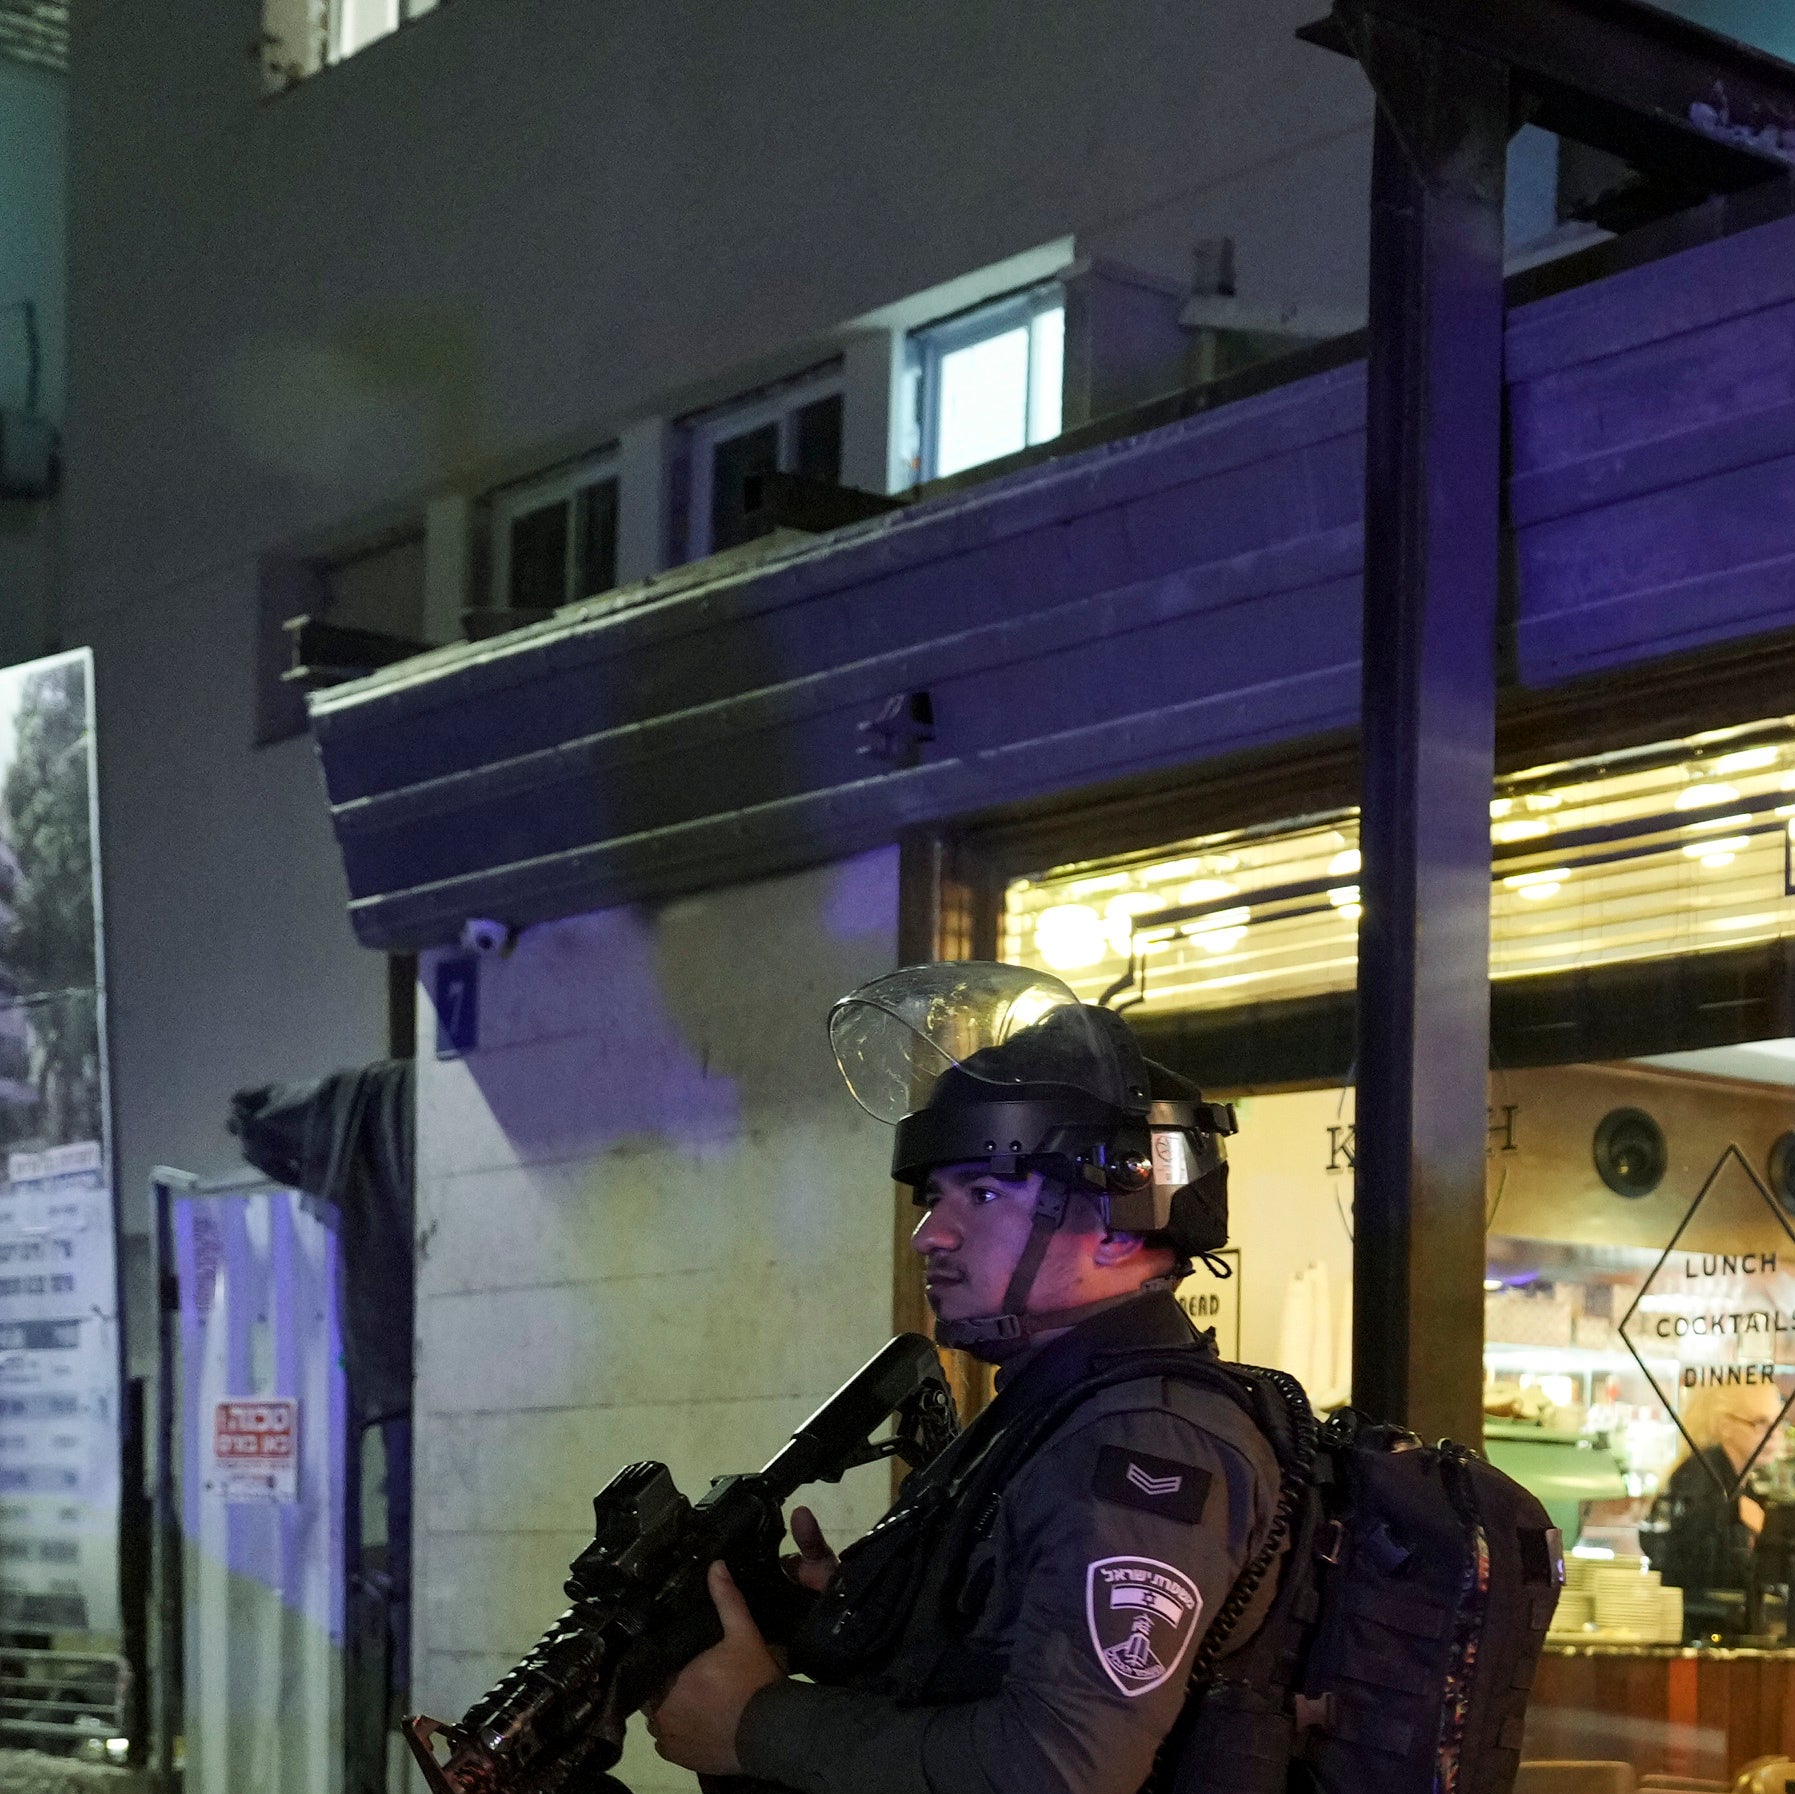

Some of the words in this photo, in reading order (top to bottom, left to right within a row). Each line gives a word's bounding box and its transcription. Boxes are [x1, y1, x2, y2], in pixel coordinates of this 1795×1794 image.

[1686, 1253, 1777, 1279] LUNCH
[1684, 1365, 1775, 1388] DINNER
[1100, 1568, 1153, 1583] ישראל
